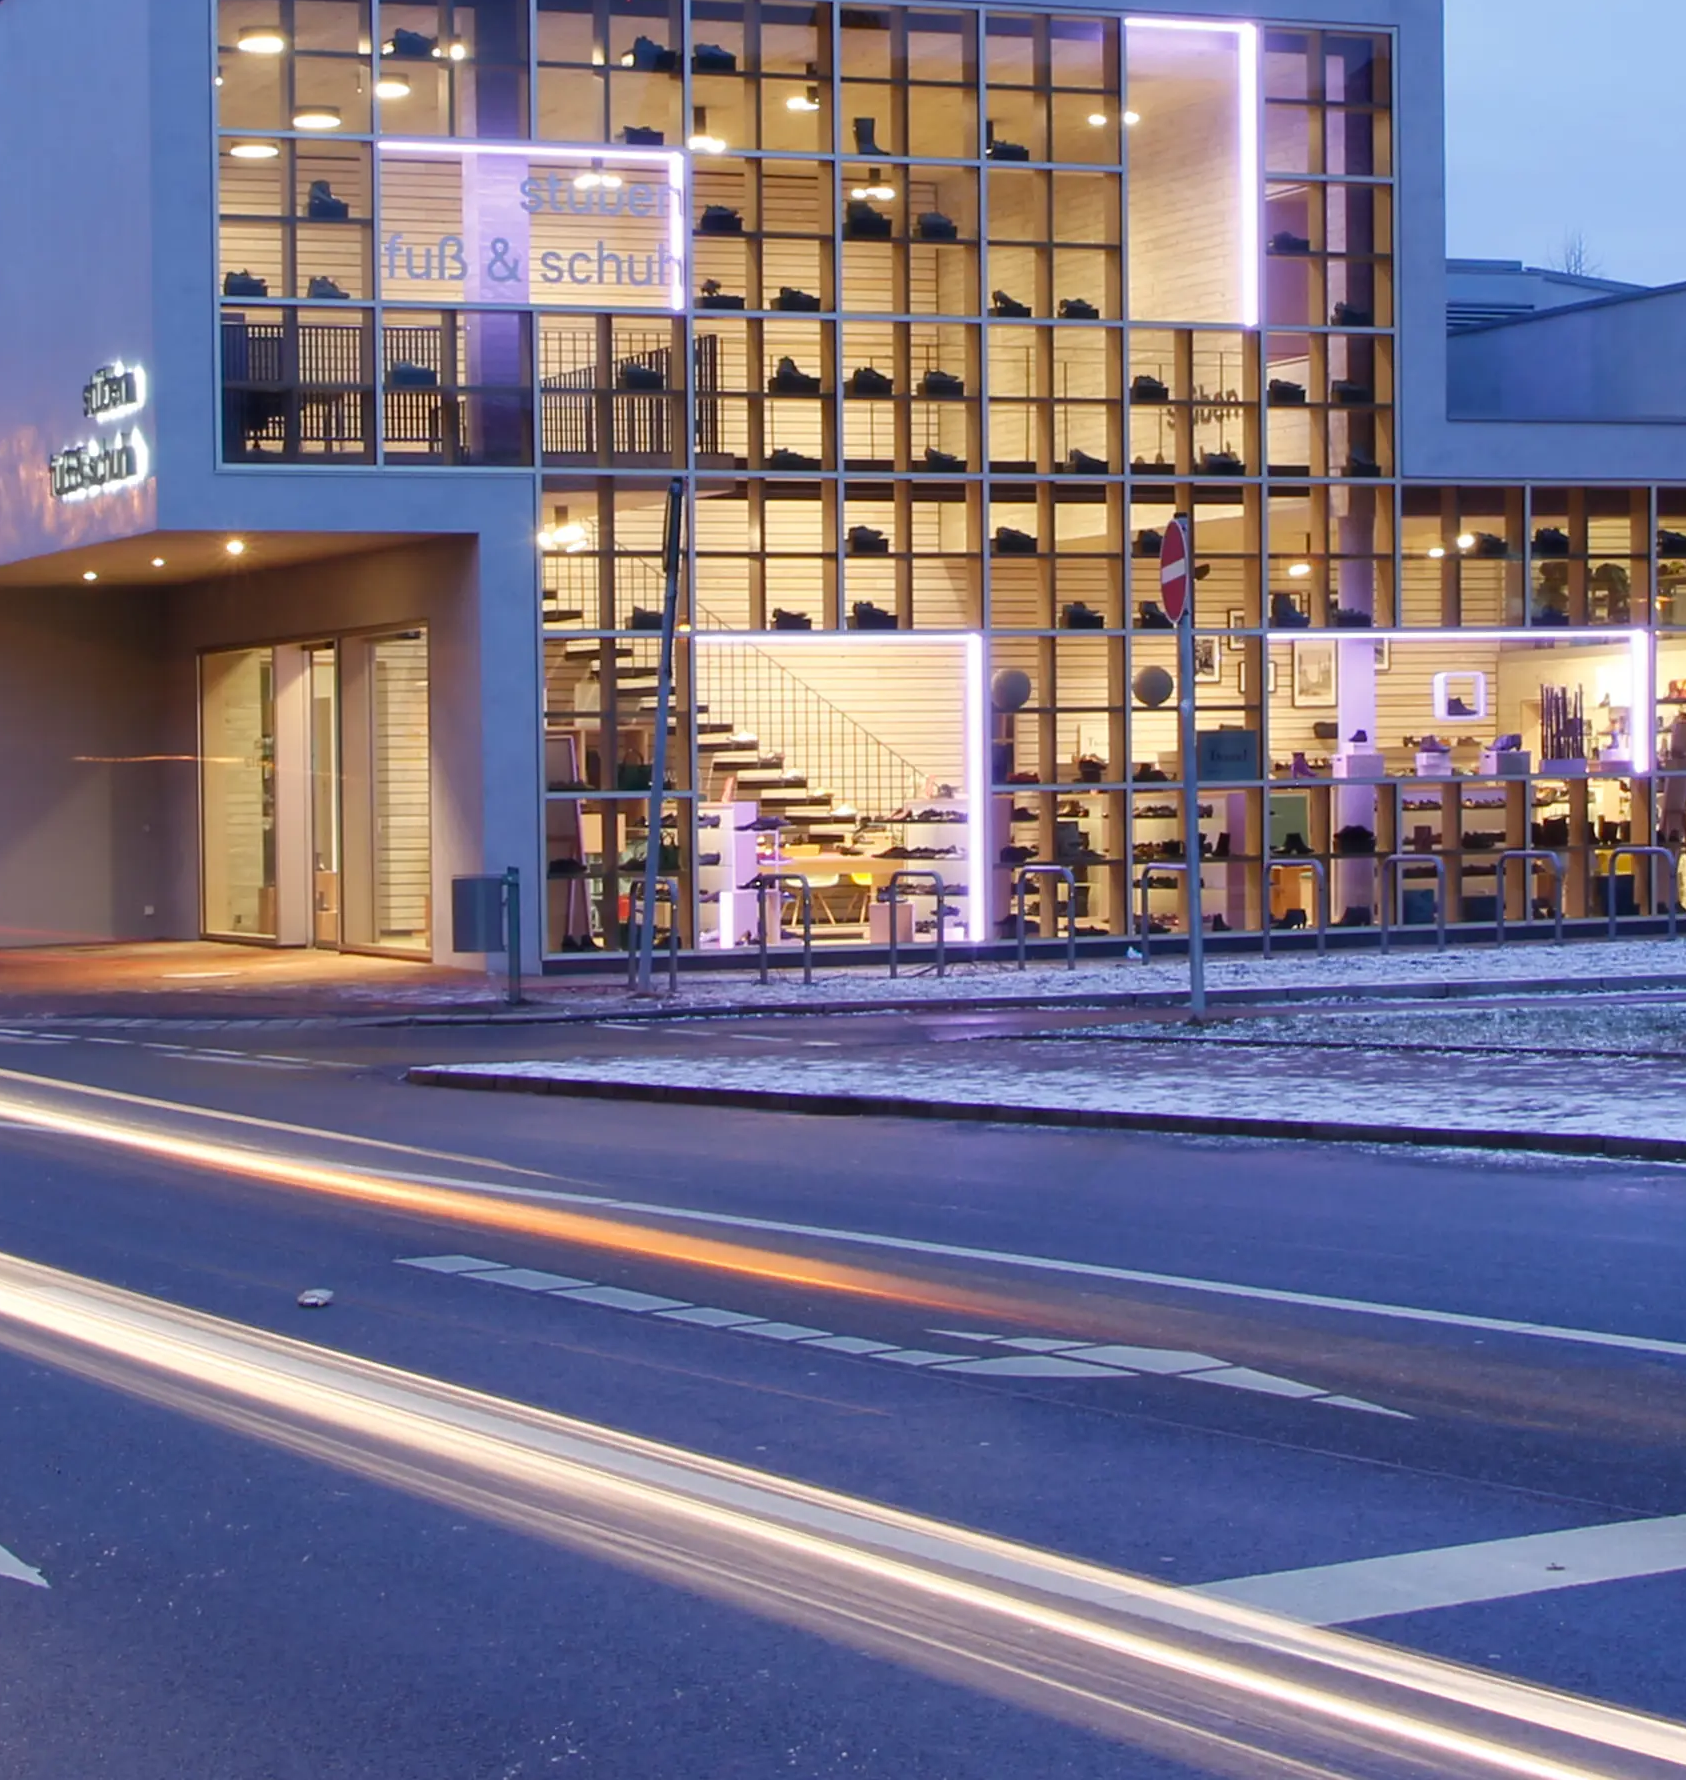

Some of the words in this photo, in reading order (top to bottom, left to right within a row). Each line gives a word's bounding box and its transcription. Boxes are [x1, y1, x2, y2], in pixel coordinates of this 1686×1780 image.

[384, 232, 469, 280] fuß
[487, 237, 522, 283] &
[540, 240, 683, 287] schuh
